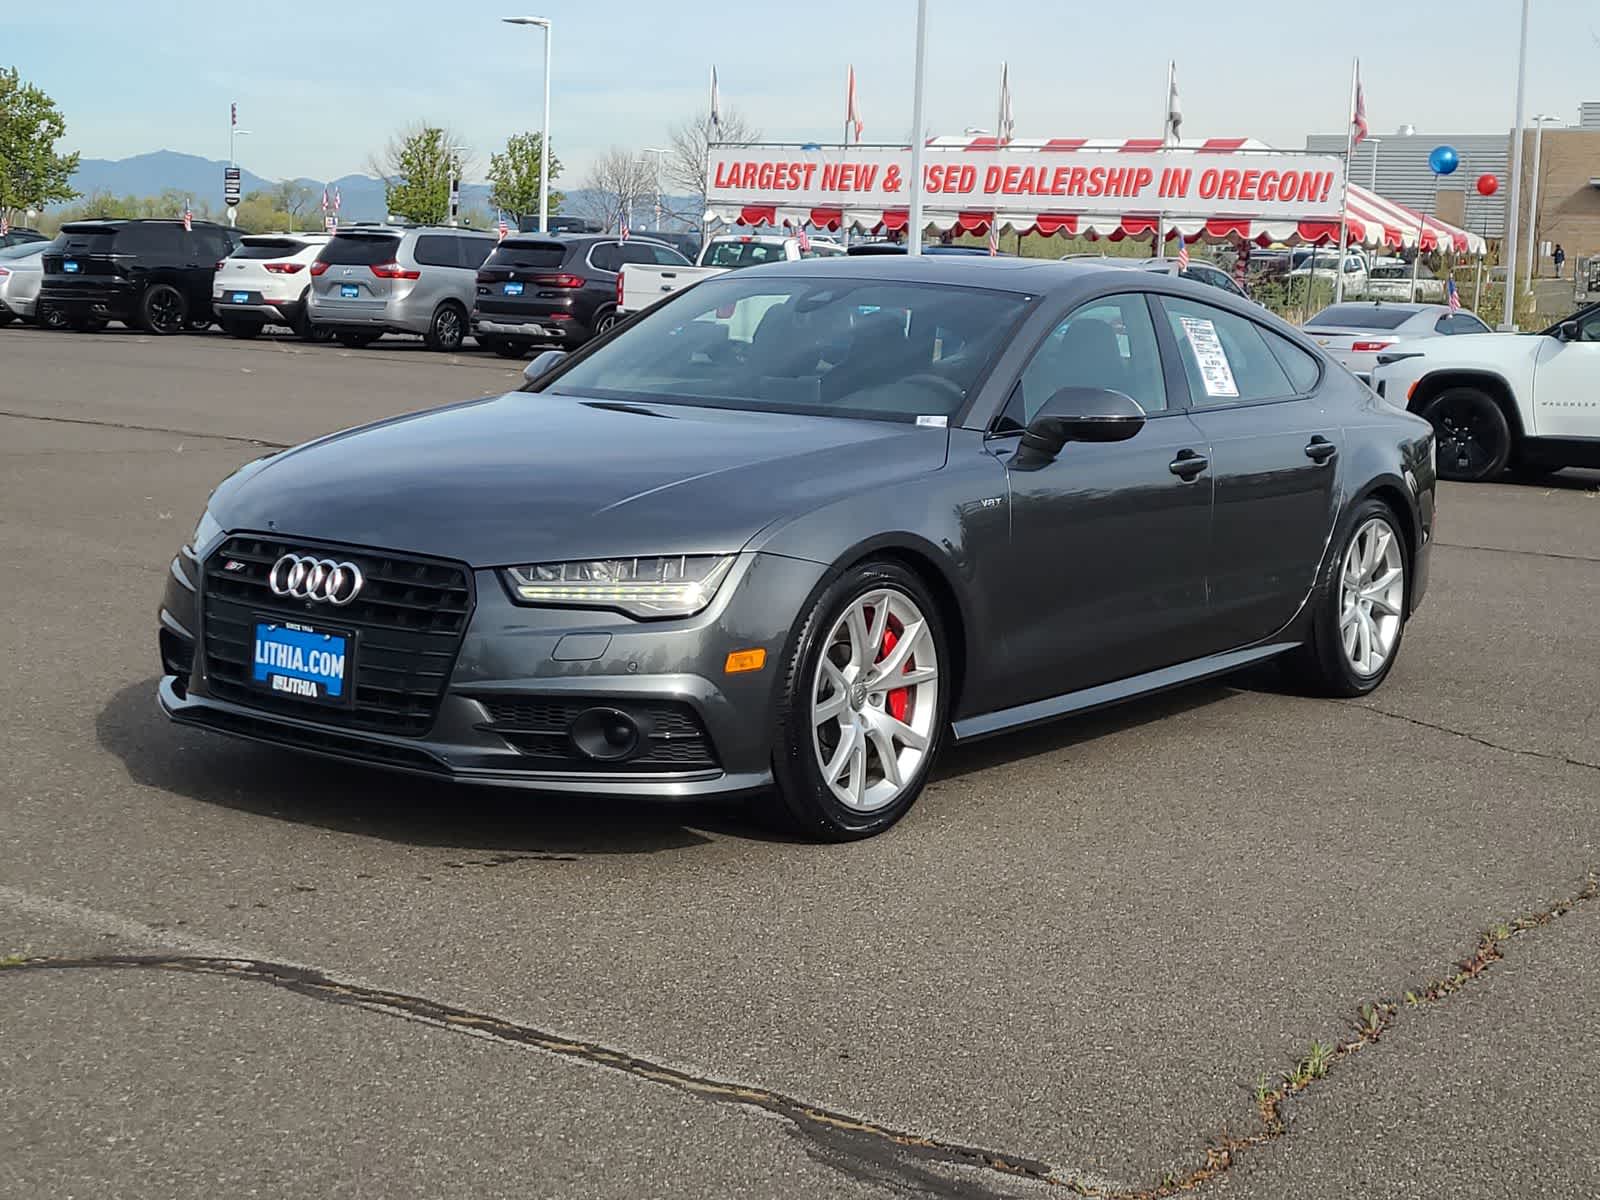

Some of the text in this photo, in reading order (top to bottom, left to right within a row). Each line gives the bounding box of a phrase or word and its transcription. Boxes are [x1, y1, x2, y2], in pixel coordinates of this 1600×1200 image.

[714, 160, 817, 191] LARGEST
[821, 163, 879, 192] NEW
[882, 164, 902, 193] &
[984, 165, 1153, 198] DEALERSHIP
[1158, 167, 1192, 199] IN
[1198, 168, 1334, 203] OREGON!
[255, 639, 345, 680] LITHIA.COM
[283, 677, 318, 698] LITHIA
